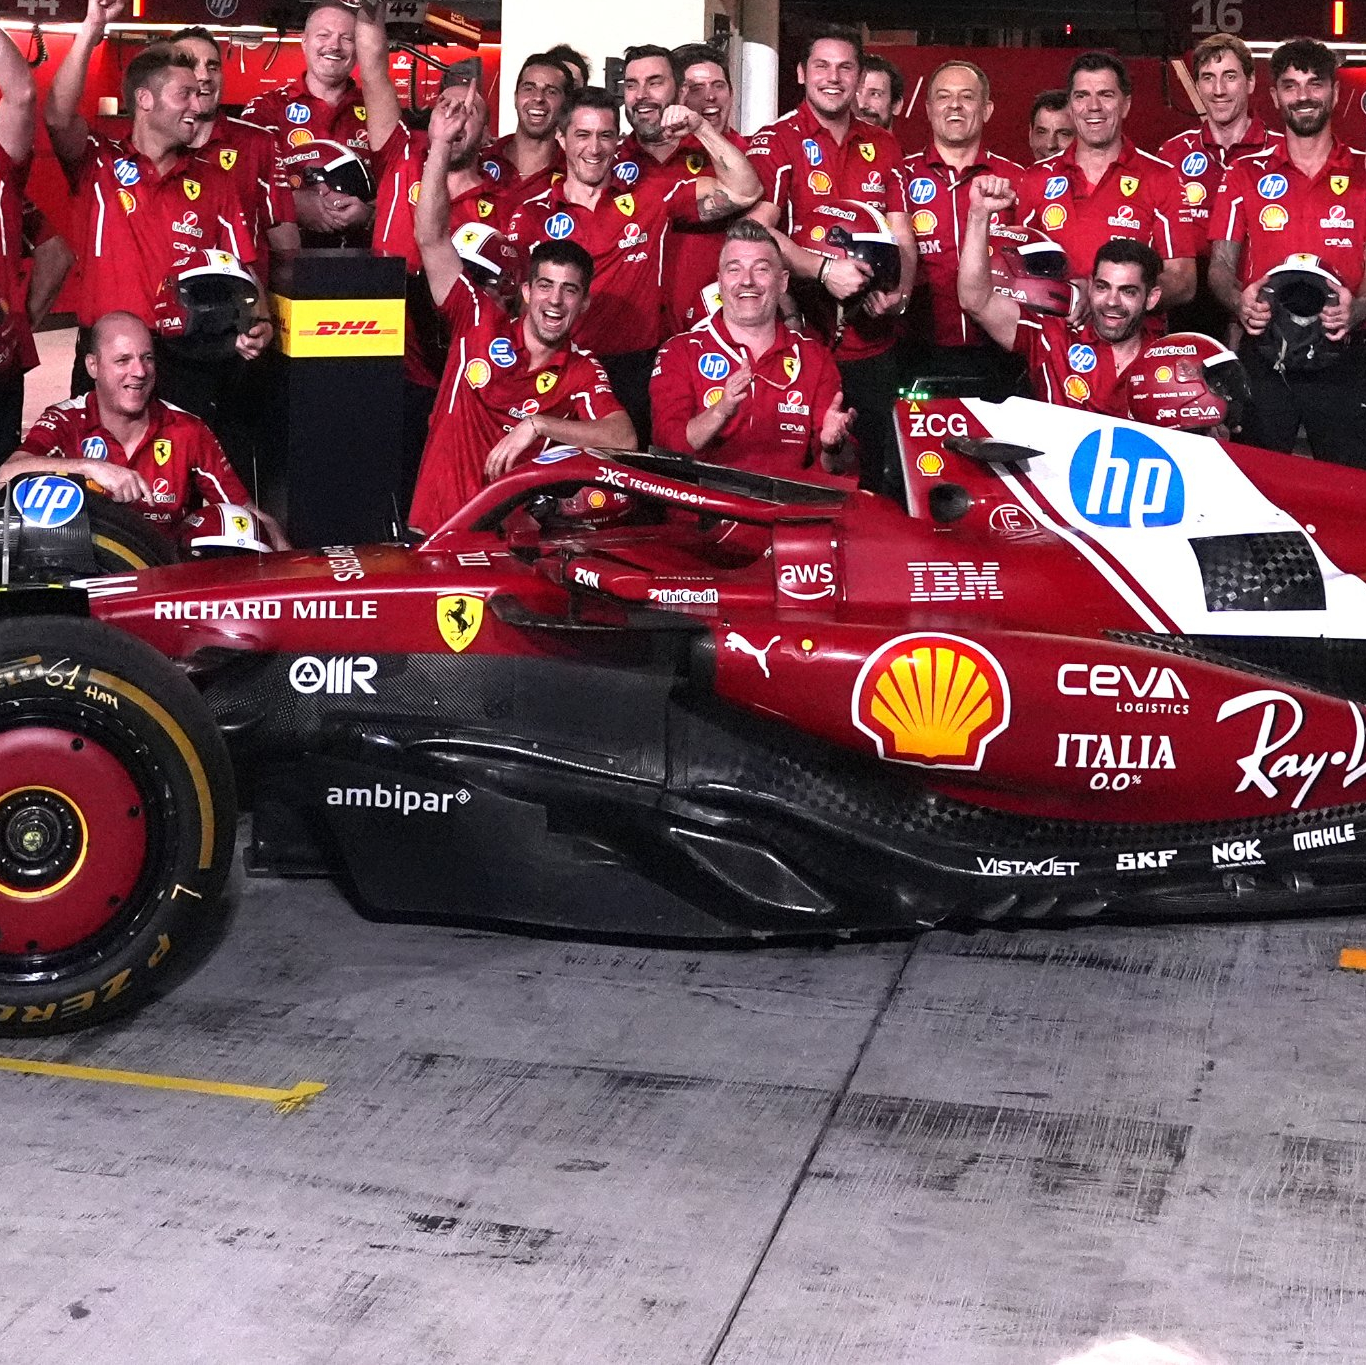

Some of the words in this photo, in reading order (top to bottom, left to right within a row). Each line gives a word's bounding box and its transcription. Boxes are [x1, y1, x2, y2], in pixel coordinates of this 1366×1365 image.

[390, 1, 417, 17] 44
[288, 102, 308, 124] hp
[116, 159, 138, 185] hp
[615, 161, 637, 183] hp
[1184, 152, 1206, 176] hp
[910, 178, 934, 203] hp
[1045, 176, 1066, 199] hp
[1260, 174, 1286, 199] hp
[820, 205, 857, 221] UniCredit
[1107, 216, 1141, 230] UniCredit
[172, 221, 203, 238] UniCredit
[547, 213, 572, 238] hp
[314, 320, 382, 336] DHL
[1069, 344, 1095, 372] hp
[1153, 345, 1198, 356] UniCredit
[701, 354, 727, 379] hp
[909, 413, 968, 437] ZCG
[595, 467, 629, 488] DXC
[629, 478, 706, 505] TECHNOLOGY
[1078, 428, 1176, 526] hp
[18, 476, 78, 527] hp
[780, 563, 834, 585] aws
[907, 562, 1004, 601] IBM
[659, 590, 719, 604] UniCredit
[154, 600, 282, 620] RICHARD
[292, 599, 378, 620] MILLE
[45, 657, 82, 690] 61
[85, 685, 119, 710] HAM
[1115, 702, 1190, 715] LOGISTICS
[1055, 733, 1176, 770] ITALIA
[1089, 772, 1142, 791] 0.0%
[326, 786, 454, 815] ambipar
[1292, 822, 1357, 851] MAHLE
[1116, 848, 1178, 870] SKF
[1211, 838, 1263, 865] NGK
